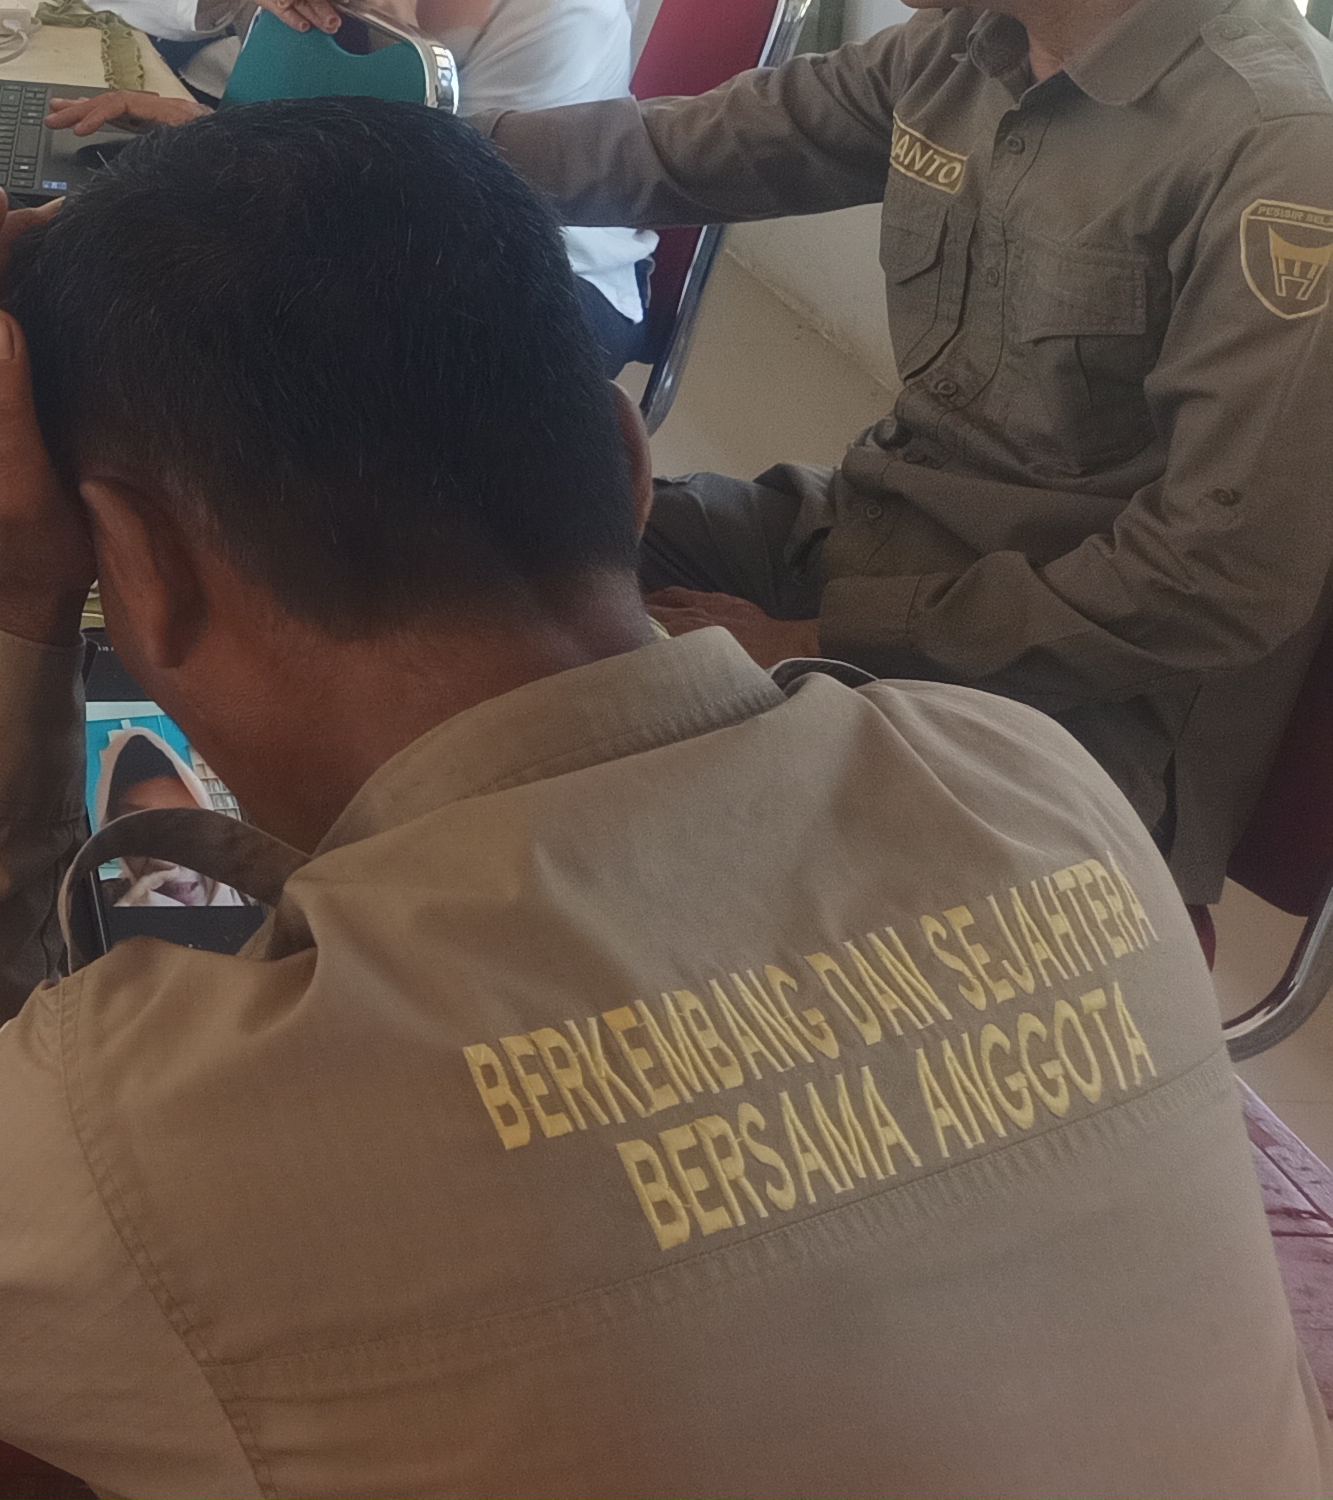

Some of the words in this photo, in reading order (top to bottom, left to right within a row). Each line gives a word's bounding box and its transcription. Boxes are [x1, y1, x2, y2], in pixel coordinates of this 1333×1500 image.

[463, 965, 840, 1151] BERKEMBANG
[805, 925, 953, 1046] DAN
[920, 850, 1159, 1011] SEJAHTERA
[617, 1066, 922, 1250] BERSAMA
[916, 981, 1158, 1157] ANGGOTA
